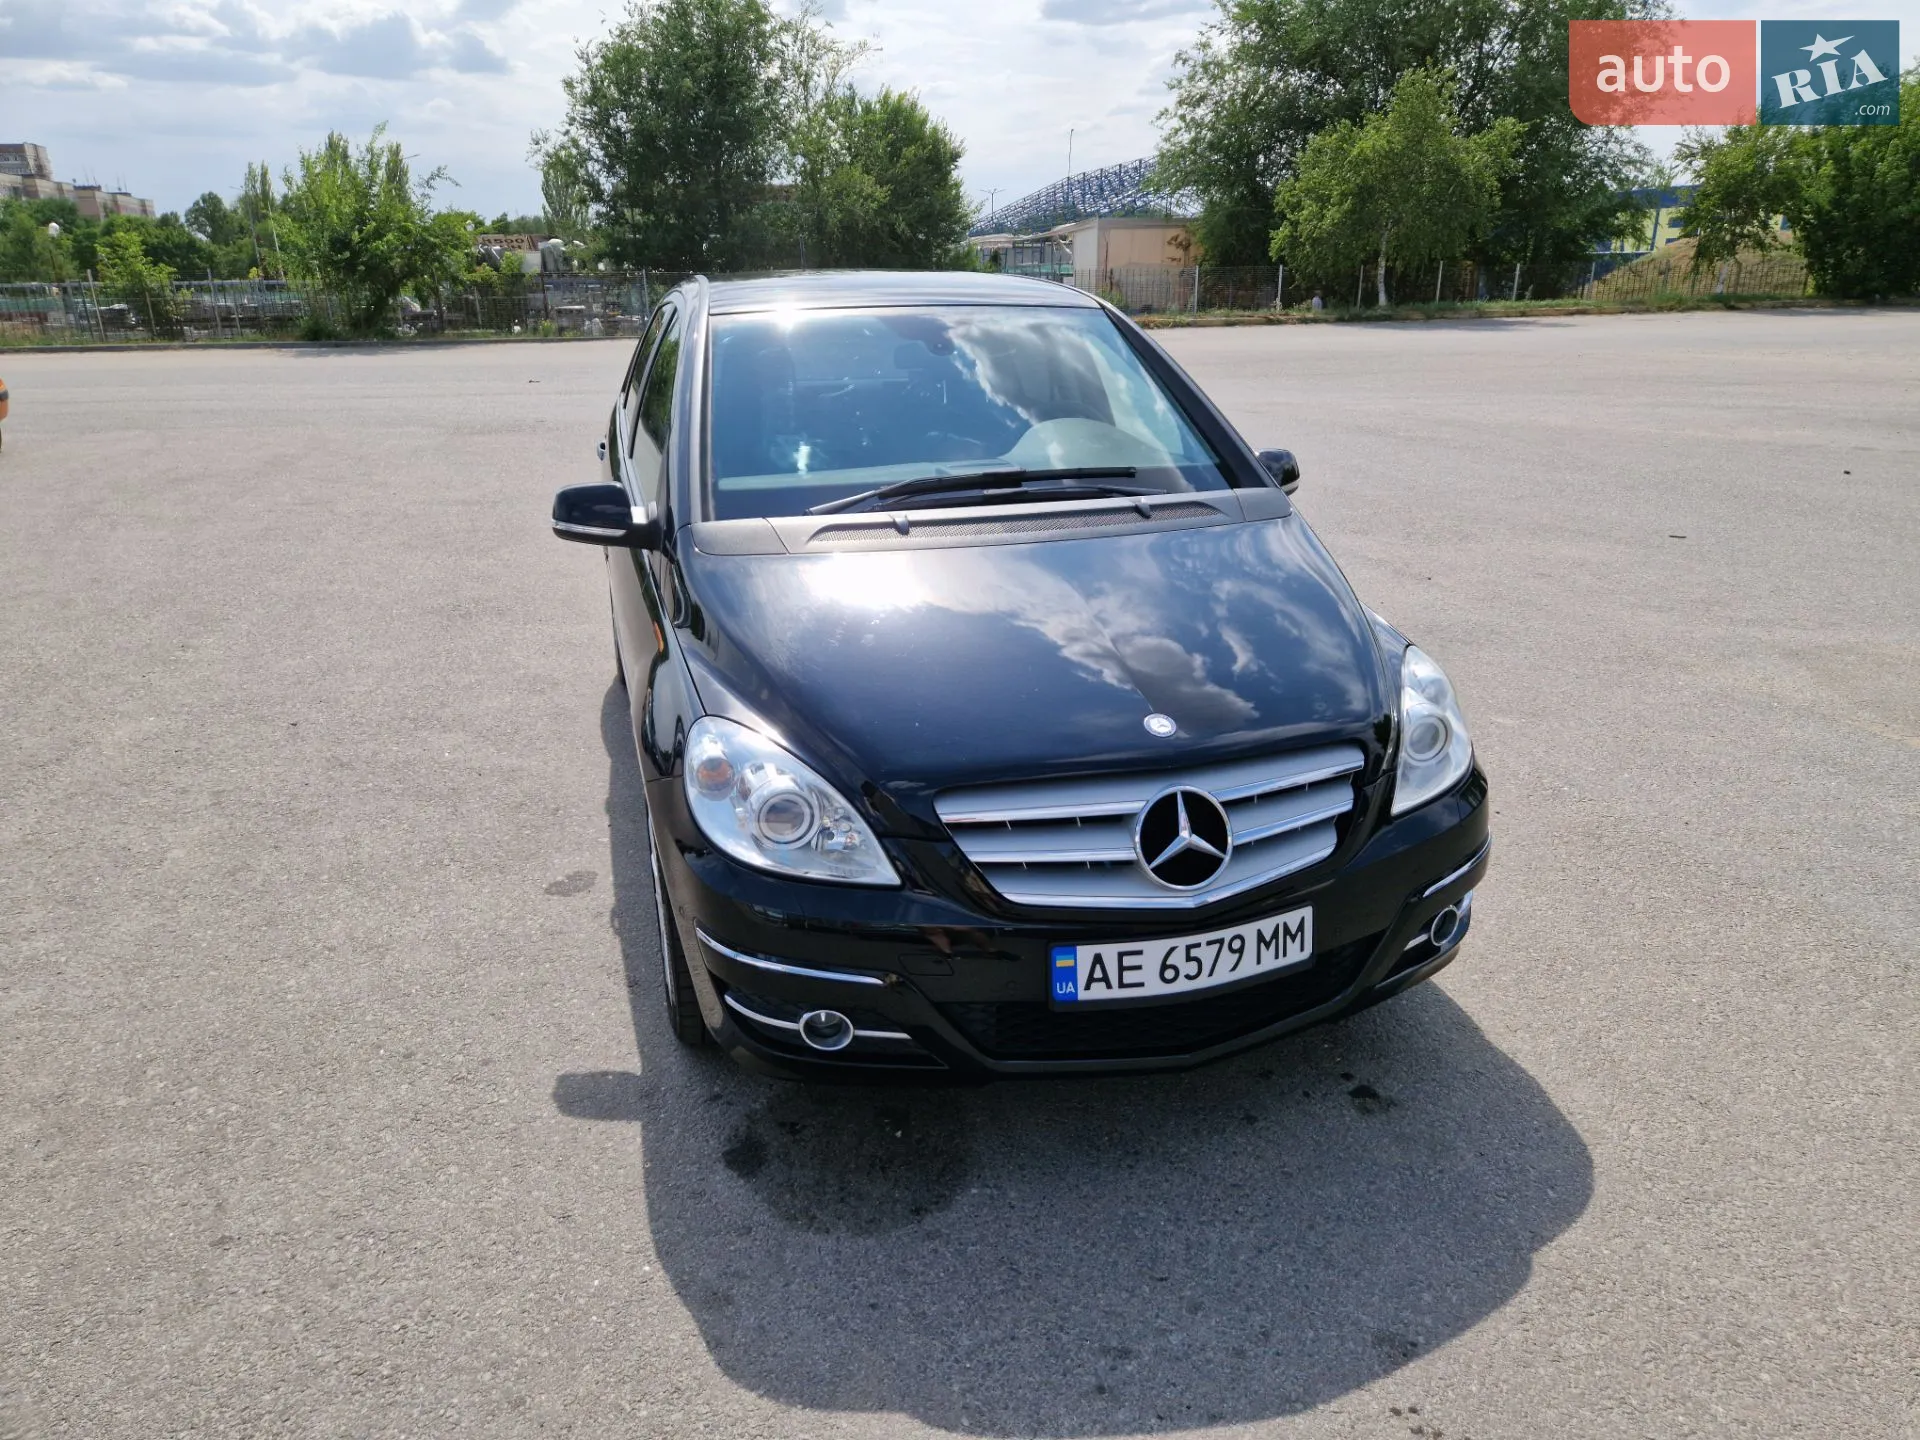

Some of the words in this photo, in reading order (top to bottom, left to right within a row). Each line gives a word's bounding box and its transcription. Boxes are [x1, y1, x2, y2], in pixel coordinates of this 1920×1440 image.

[1083, 949, 1146, 991] AE
[1158, 933, 1246, 985] 6579
[1256, 915, 1306, 966] MM
[1056, 981, 1076, 994] UA
